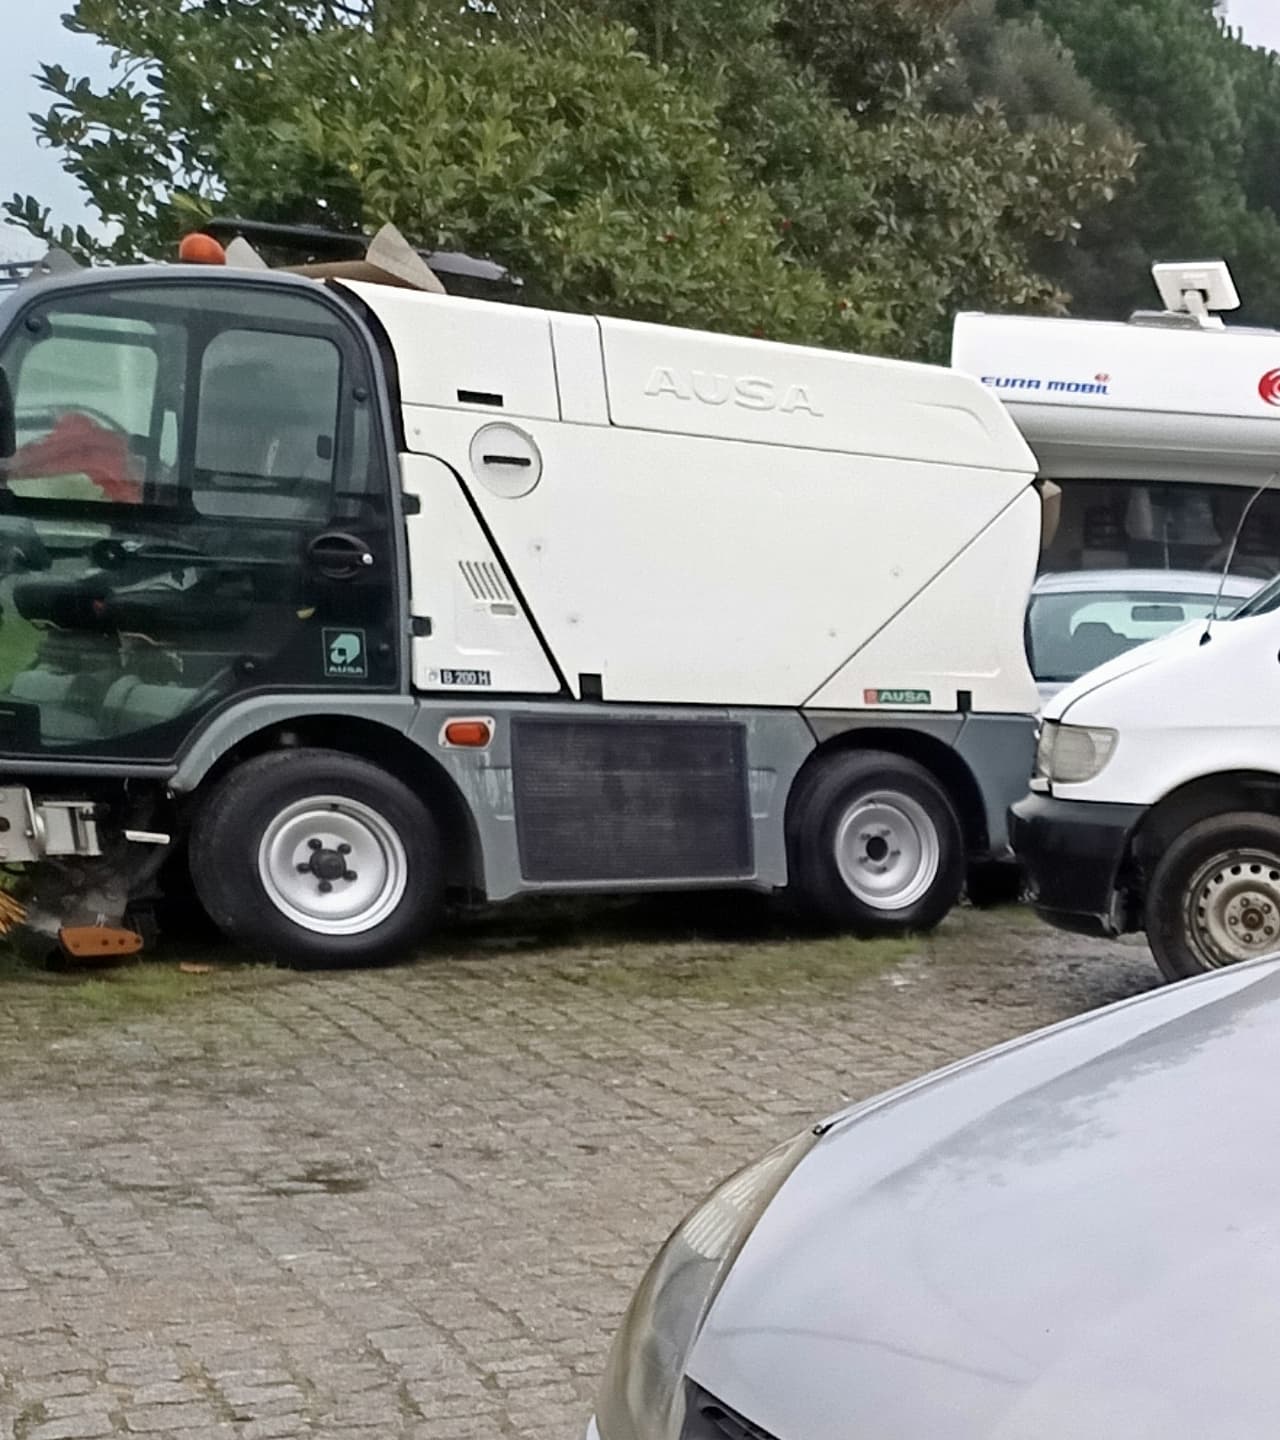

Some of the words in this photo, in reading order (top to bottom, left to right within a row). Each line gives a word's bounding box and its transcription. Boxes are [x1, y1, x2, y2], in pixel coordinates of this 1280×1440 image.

[643, 365, 825, 417] AUSA
[1046, 380, 1110, 395] MOBIL
[880, 690, 930, 703] AUSA
